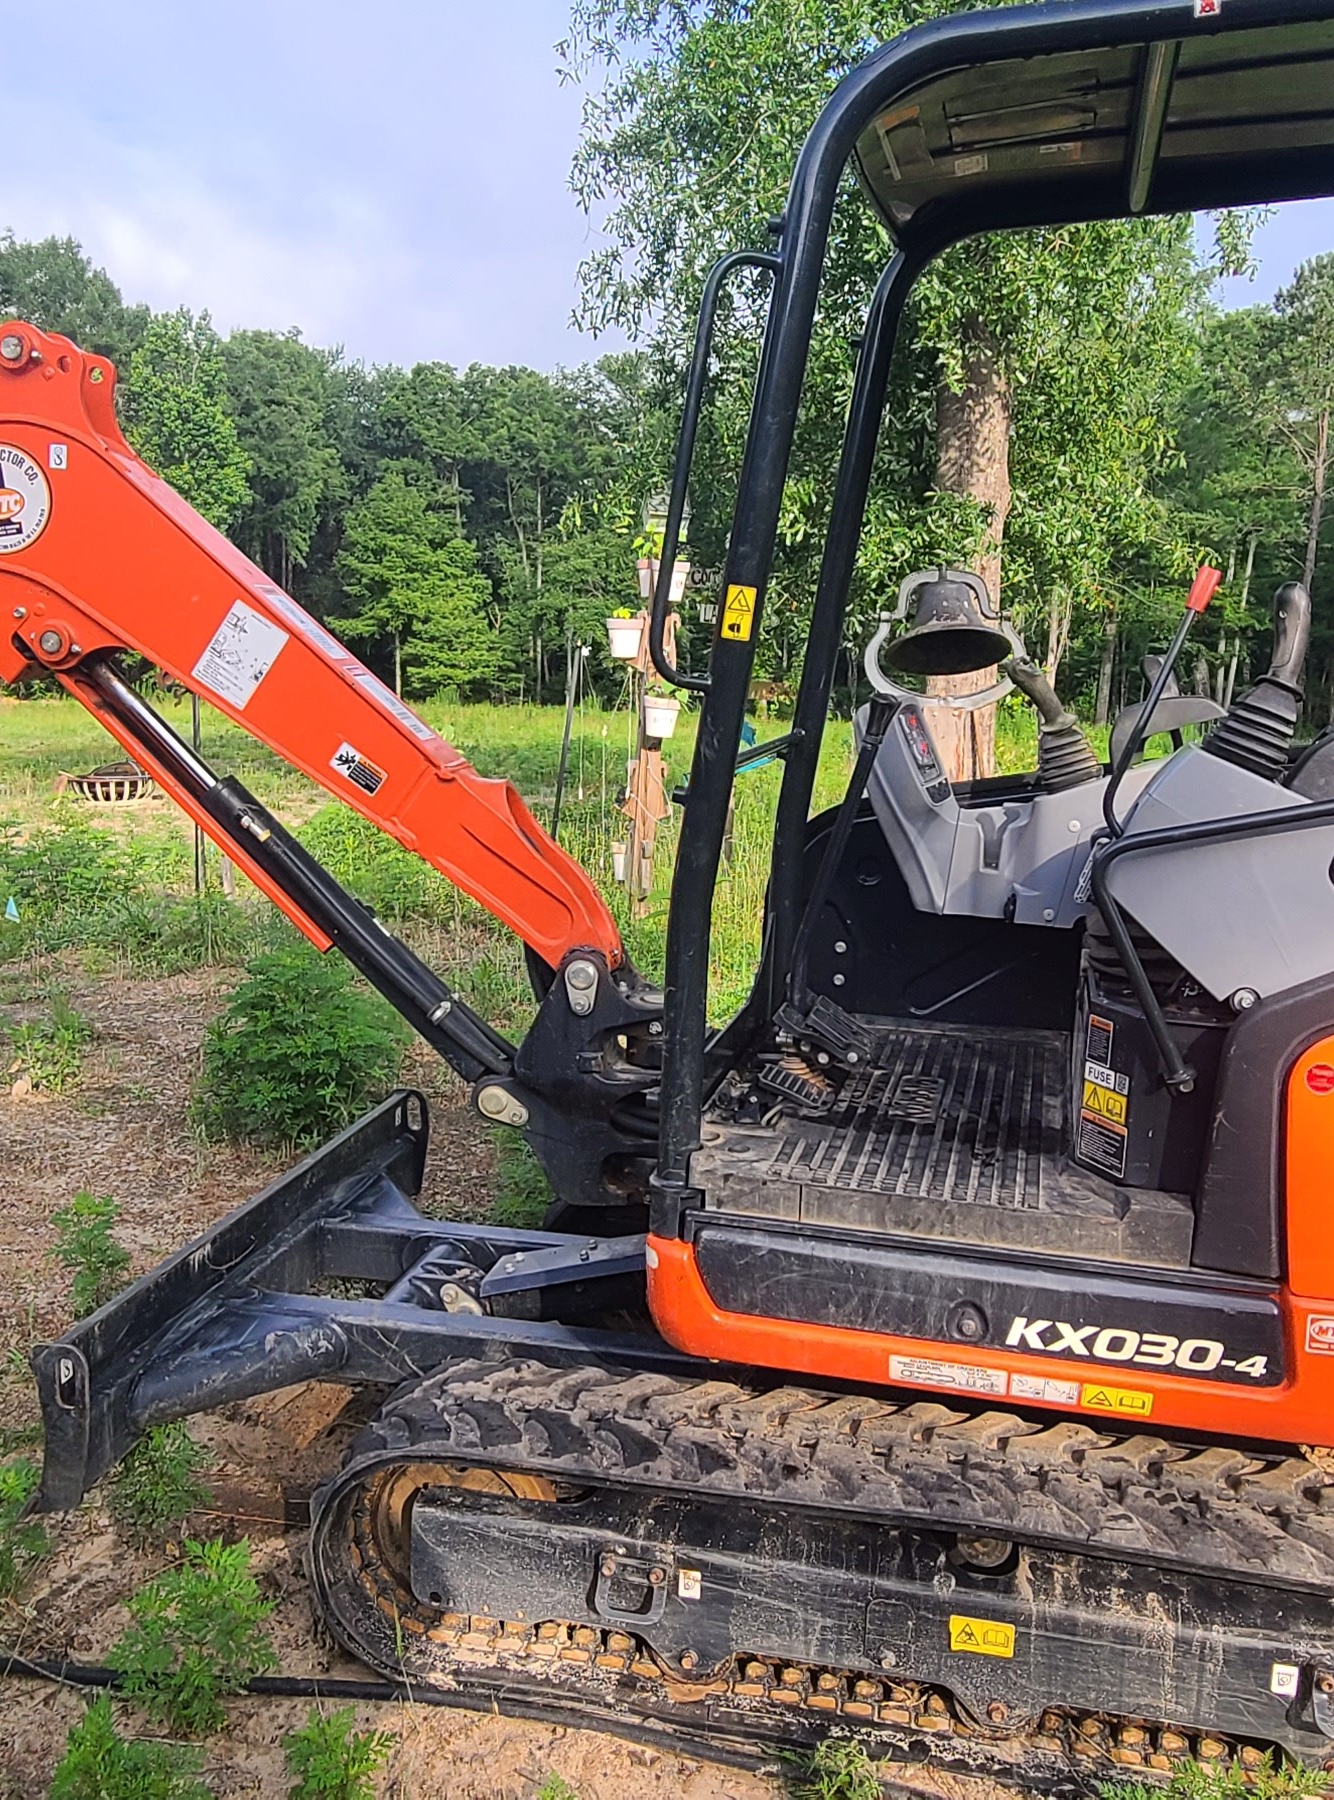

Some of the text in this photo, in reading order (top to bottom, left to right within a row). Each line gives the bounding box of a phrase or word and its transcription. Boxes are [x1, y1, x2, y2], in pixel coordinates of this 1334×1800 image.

[24, 465, 38, 485] CO.
[1088, 1066, 1113, 1085] FUSE
[1006, 1316, 1268, 1378] KX030-4
